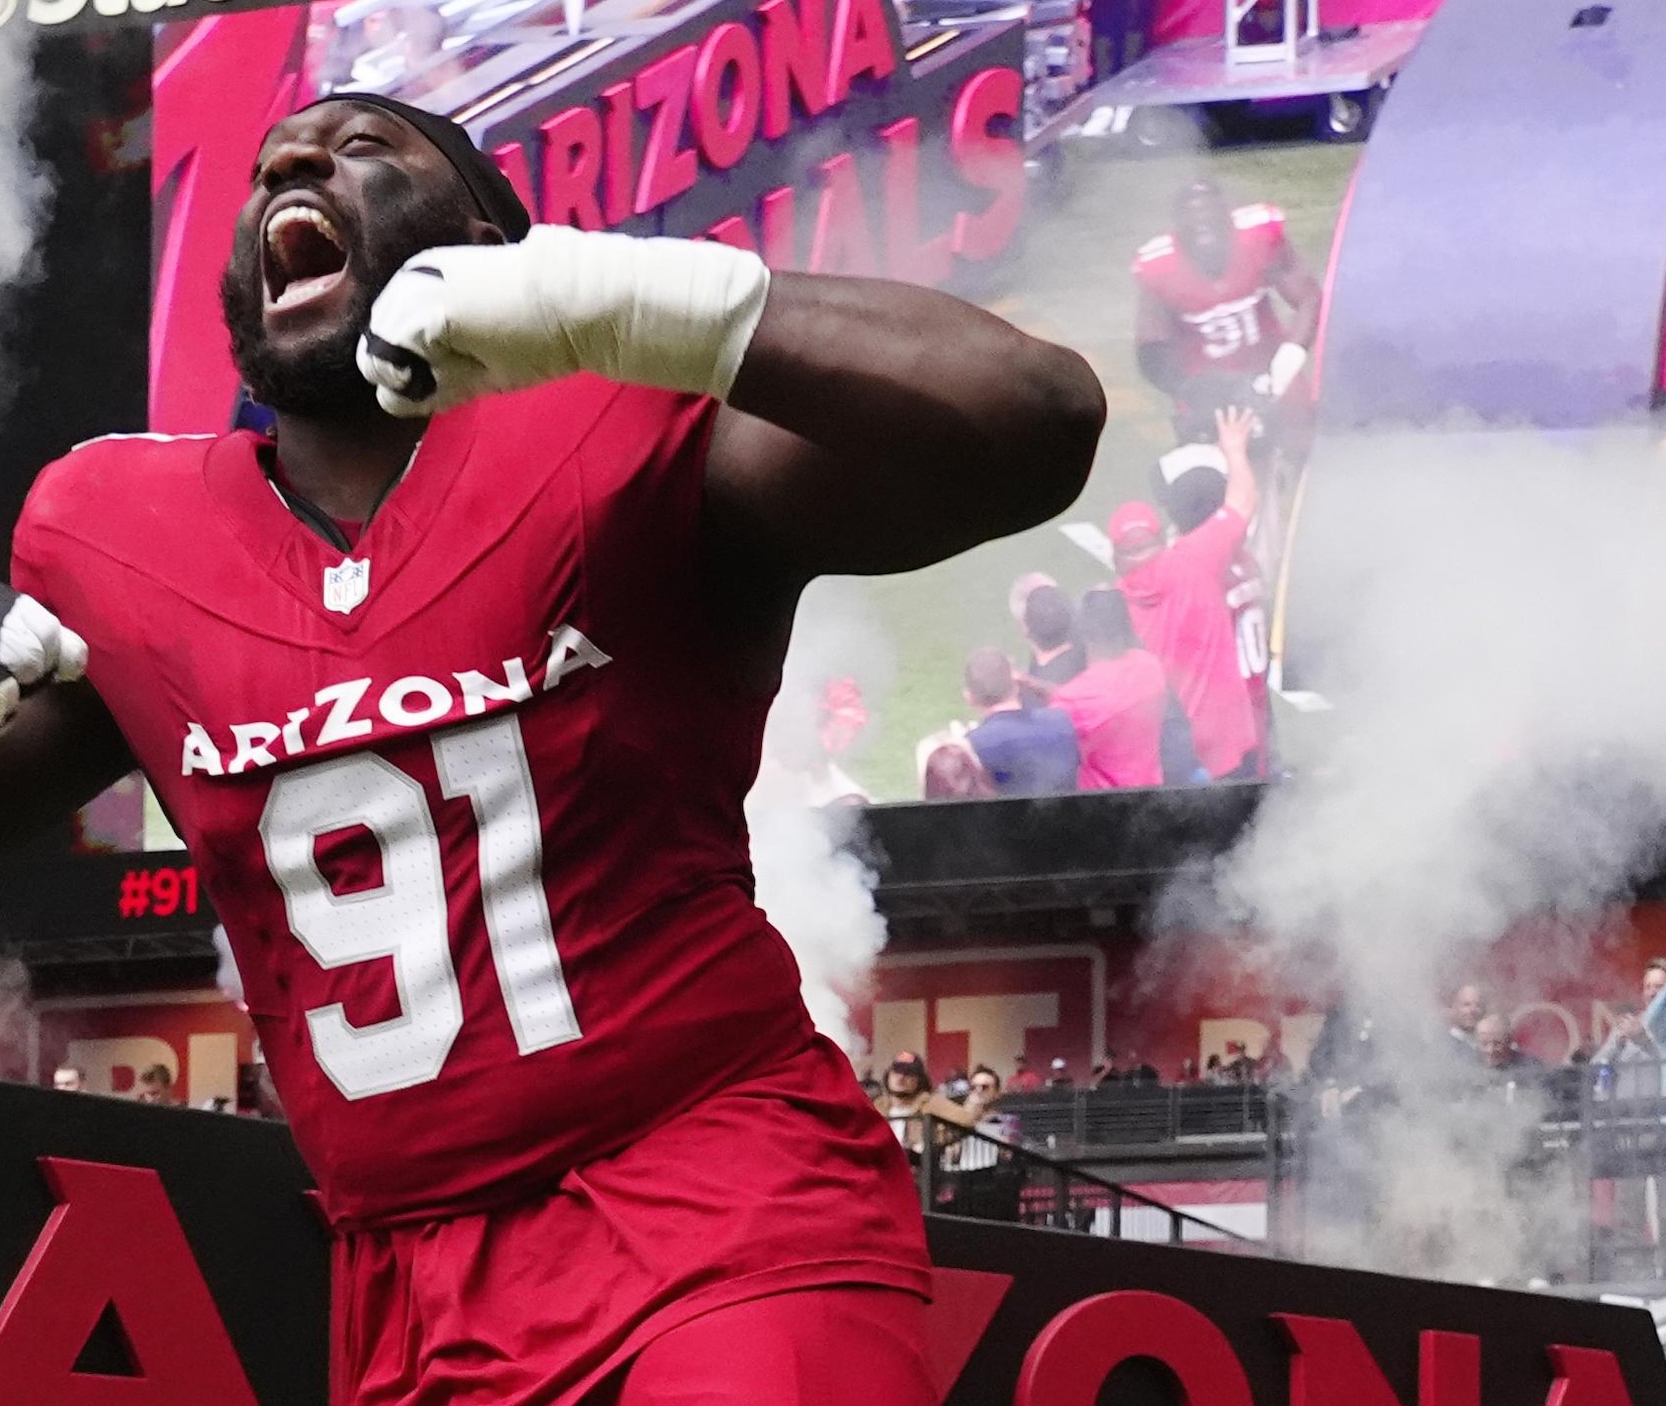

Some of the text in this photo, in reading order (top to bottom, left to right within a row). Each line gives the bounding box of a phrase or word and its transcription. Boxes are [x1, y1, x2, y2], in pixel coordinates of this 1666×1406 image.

[181, 623, 613, 777] ARIZONA
[118, 866, 198, 919] #91
[257, 711, 584, 1102] 91
